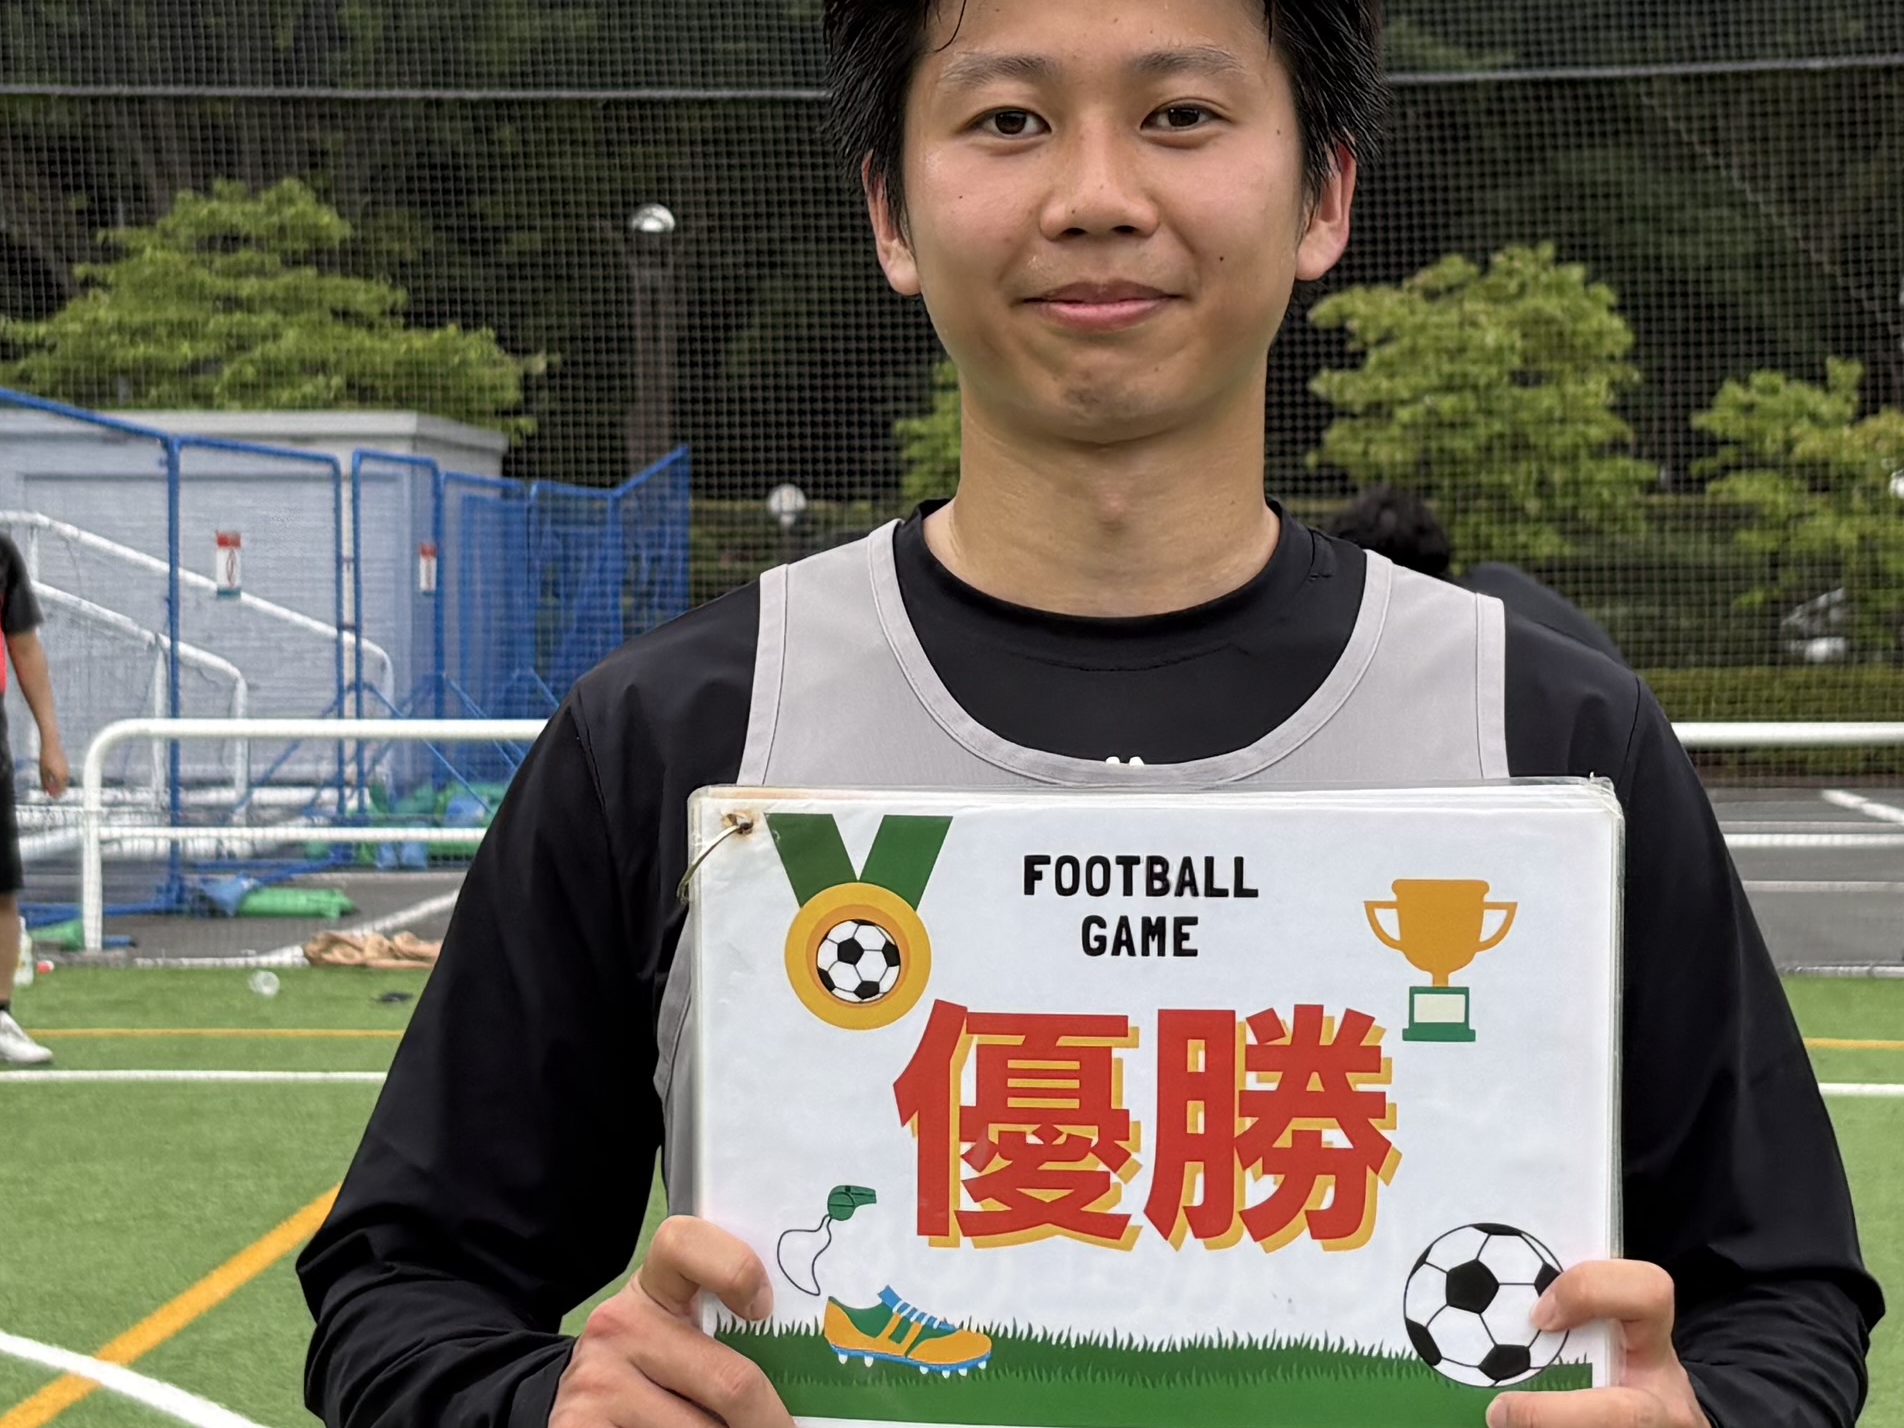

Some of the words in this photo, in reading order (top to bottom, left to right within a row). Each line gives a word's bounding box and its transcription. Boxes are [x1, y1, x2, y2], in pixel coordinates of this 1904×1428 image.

[1024, 855, 1259, 898] FOOTBALL
[1081, 915, 1199, 957] GAME
[893, 999, 1402, 1251] 優勝
